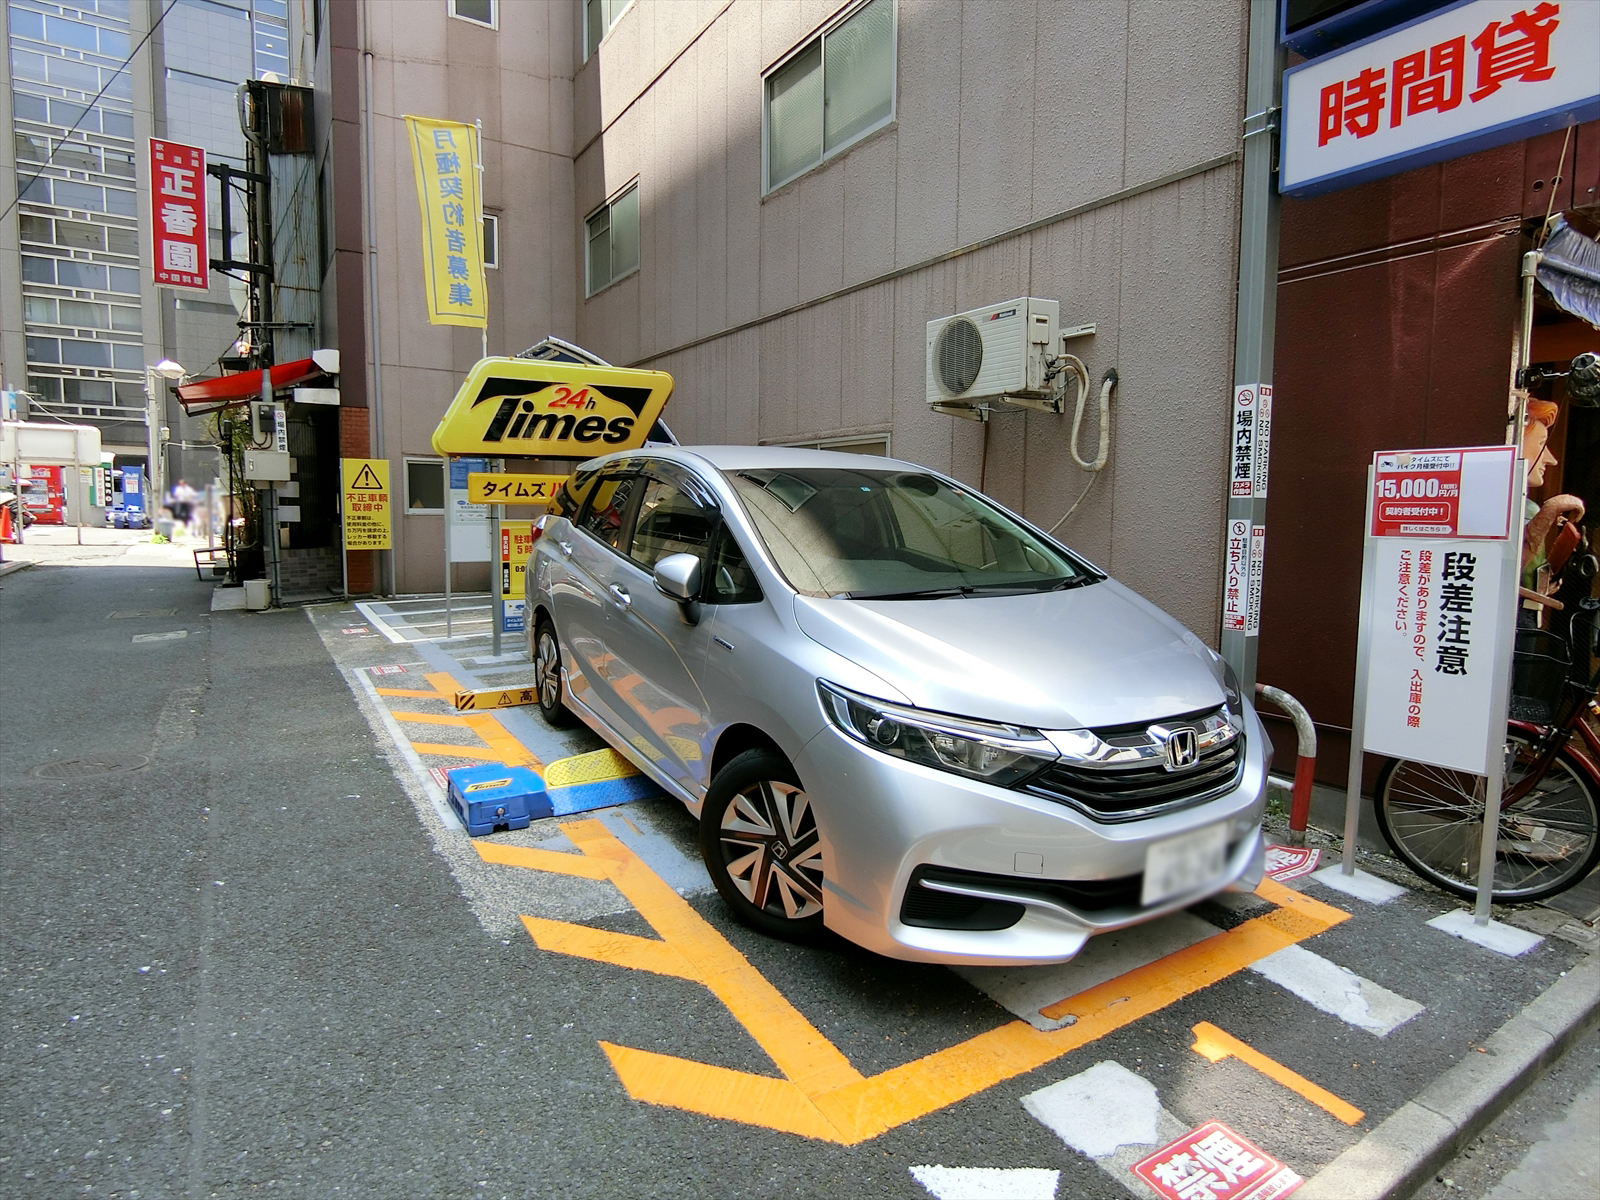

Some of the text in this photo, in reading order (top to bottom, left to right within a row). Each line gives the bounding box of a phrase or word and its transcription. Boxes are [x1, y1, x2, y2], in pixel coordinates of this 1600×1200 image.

[1317, 2, 1560, 147] 時間貸
[160, 165, 198, 274] 正香園
[474, 383, 636, 443] Times
[1235, 410, 1253, 479] 場内禁煙
[482, 481, 546, 497] タイムズ
[1376, 478, 1439, 499] 15,000
[1226, 537, 1241, 613] 立ち入り禁止
[1395, 550, 1412, 637] ご注意ください。
[1435, 551, 1477, 676] 段差注意
[519, 690, 533, 703] 高
